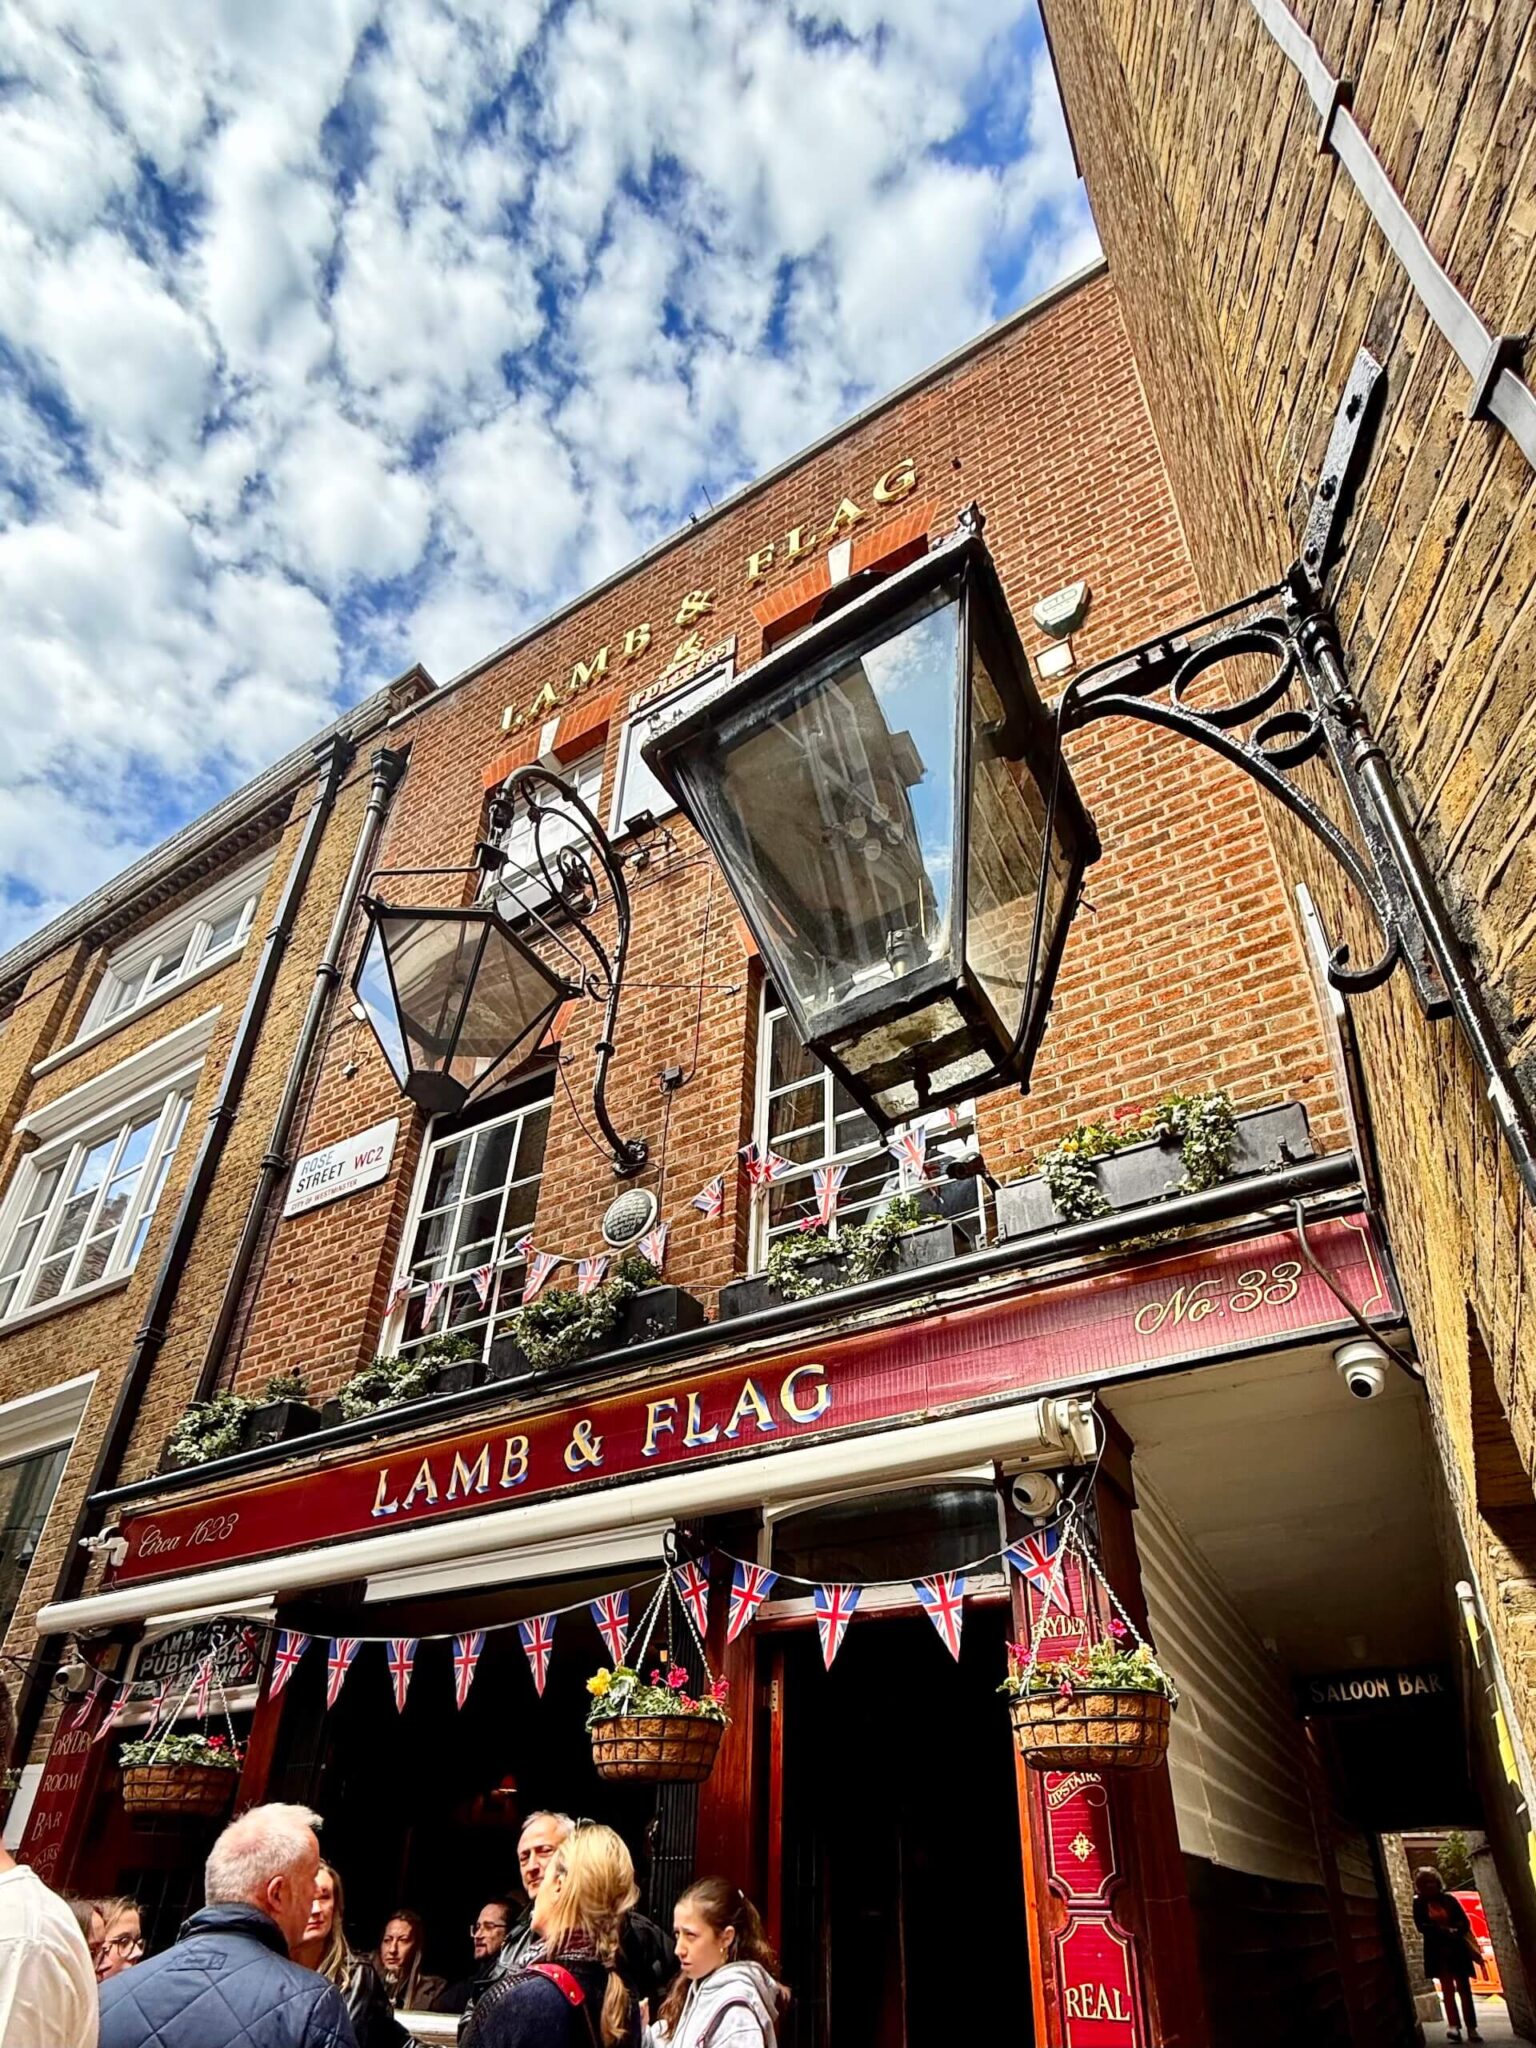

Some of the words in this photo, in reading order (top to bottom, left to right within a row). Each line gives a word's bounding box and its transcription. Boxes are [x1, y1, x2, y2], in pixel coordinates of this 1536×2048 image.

[501, 623, 650, 731] LAMB
[674, 587, 716, 626] &
[744, 458, 918, 587] FLAG
[296, 1161, 346, 1193] STREET
[354, 1146, 384, 1170] WC2
[301, 1151, 334, 1176] ROSE
[291, 1202, 304, 1211] CITY
[315, 1179, 357, 1201] WESTMINSTER
[1135, 1277, 1225, 1334] No.
[1230, 1261, 1302, 1312] 33
[371, 1434, 529, 1517] LAMB
[564, 1419, 604, 1472] &
[641, 1363, 833, 1457] FLAG
[138, 1524, 182, 1557] Circa
[186, 1512, 239, 1547] 1623
[1310, 1679, 1390, 1703] SALOON
[1398, 1673, 1444, 1696] BAR
[52, 1730, 91, 1756] DRYDEN
[43, 1773, 79, 1792] ROOM
[31, 1811, 63, 1841] BAR
[1064, 1983, 1130, 2021] REAL
